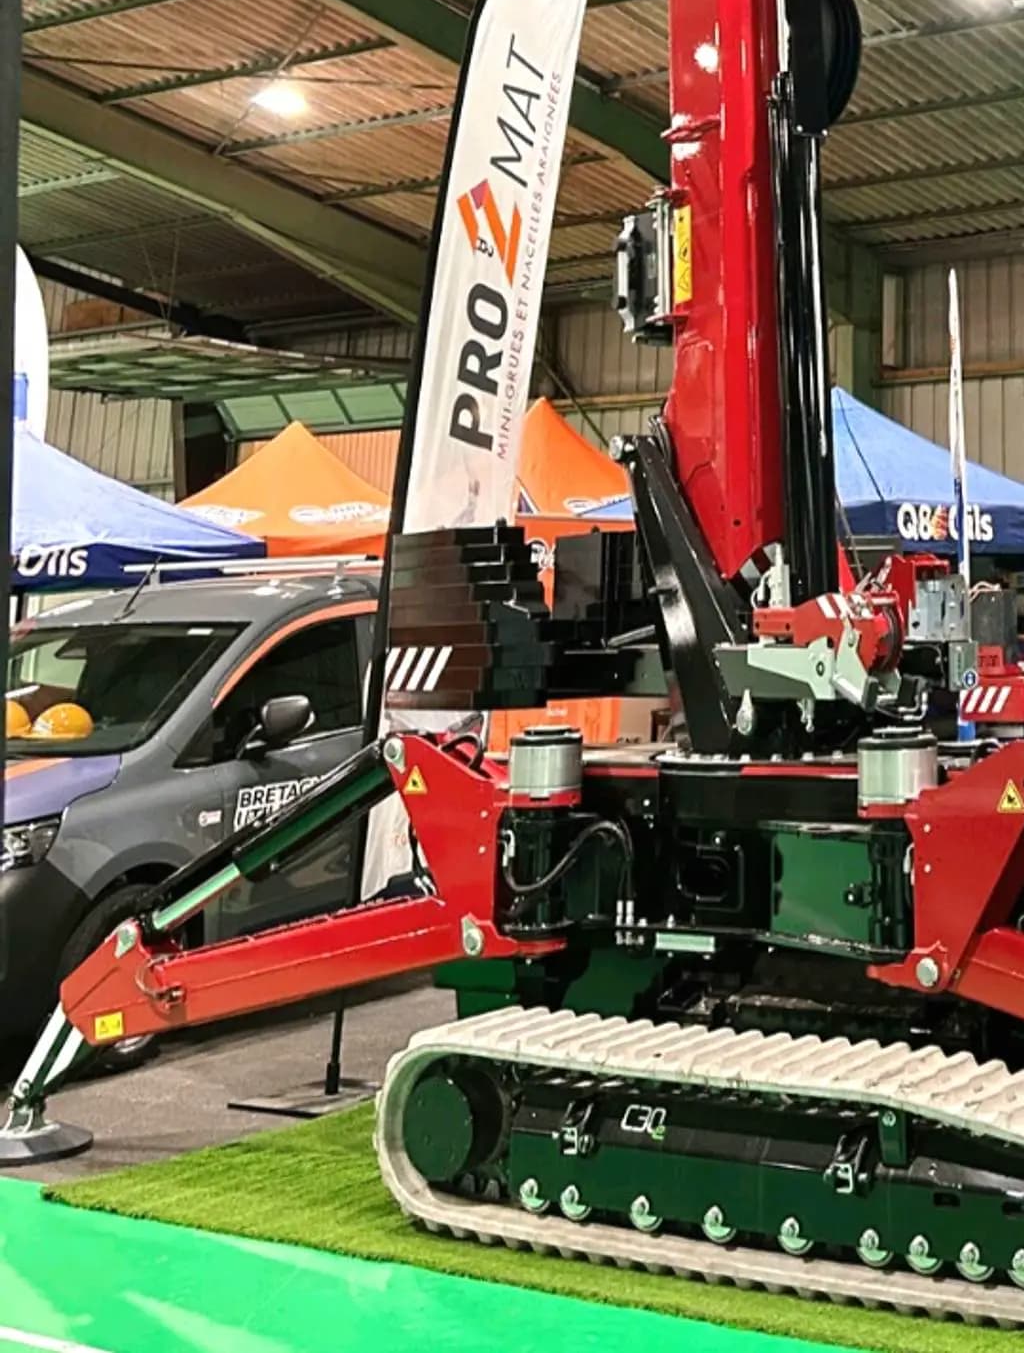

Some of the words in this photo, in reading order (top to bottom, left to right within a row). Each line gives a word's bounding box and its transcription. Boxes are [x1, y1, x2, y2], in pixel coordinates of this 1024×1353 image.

[449, 282, 508, 453] PRO
[489, 33, 544, 188] MAT
[520, 192, 543, 290] NACELLES
[516, 298, 529, 321] ET
[497, 329, 525, 459] MINI-GRUES
